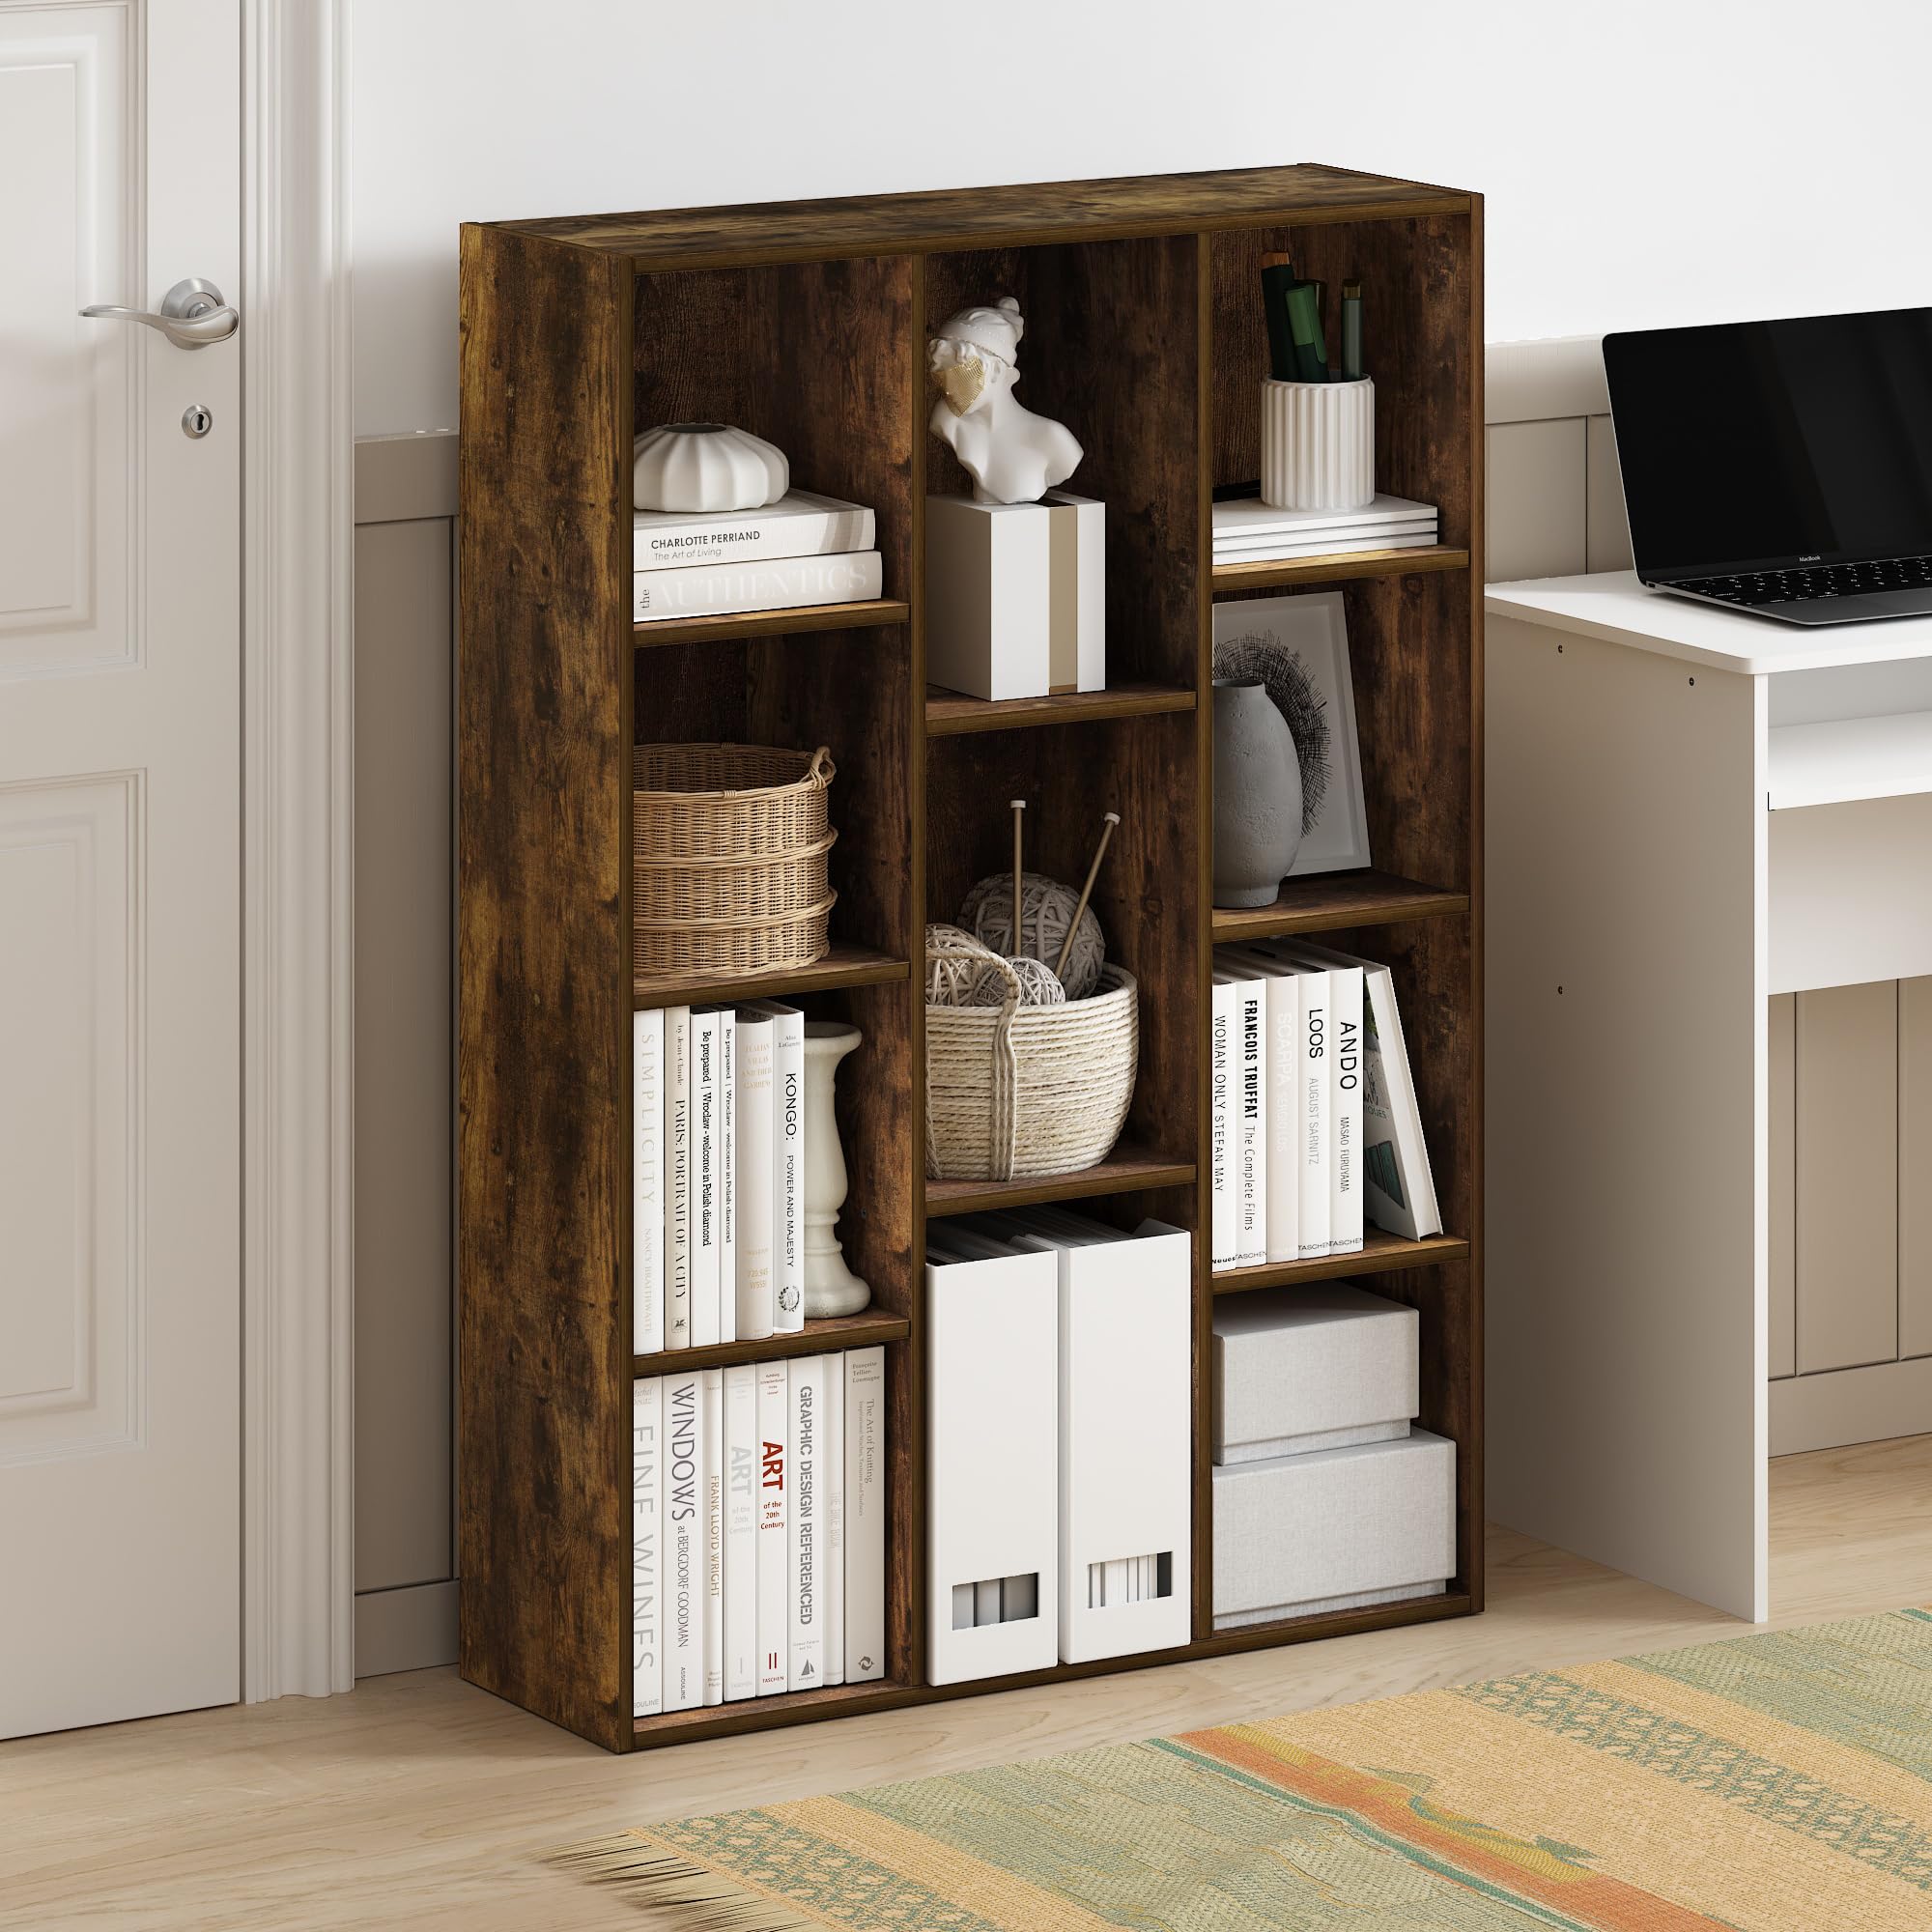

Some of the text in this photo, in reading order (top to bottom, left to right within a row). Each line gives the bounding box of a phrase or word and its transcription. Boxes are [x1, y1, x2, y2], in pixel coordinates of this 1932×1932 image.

[651, 530, 760, 550] CHARLOTTE PERRIAND
[654, 548, 722, 561] The Art of Living
[639, 588, 650, 609] the
[702, 1030, 712, 1042] Be
[725, 1029, 732, 1039] Be
[700, 1043, 712, 1083] prepared
[785, 1072, 797, 1142] KONGO:
[1214, 1015, 1227, 1191] WOMAN ONLY STEFAN MAY
[1308, 1009, 1324, 1166] LOOS AUGUST SARNITZ
[1339, 1021, 1357, 1194] ANDO MASAO FURUYAMA
[641, 1034, 656, 1204] SIMPLICITY
[702, 1092, 712, 1130] Wroclaw
[1241, 999, 1259, 1232] FRANCOIS TRUFFAT The Complete Films
[702, 1134, 712, 1173] welcome
[702, 1174, 712, 1183] in
[702, 1183, 712, 1208] Polish
[725, 1172, 732, 1180] in
[675, 1099, 686, 1300] PARIS: PORTRAIT OF A CITY
[702, 1208, 712, 1247] diamond
[800, 1385, 812, 1457] GRAPHIC
[864, 1398, 876, 1485] The Art of Knitting
[731, 1445, 752, 1496] ART
[762, 1441, 783, 1492] ART
[771, 1500, 782, 1509] the
[800, 1460, 812, 1518] DESIGN
[671, 1381, 696, 1648] WINDOWS at BERGDORF GOODMAN
[760, 1520, 784, 1530] Century
[765, 1511, 780, 1520] 20th
[710, 1475, 720, 1598] FRANK LLOYD WRIGHT
[800, 1521, 812, 1626] REFERENCED
[634, 1698, 660, 1709] OULINE
